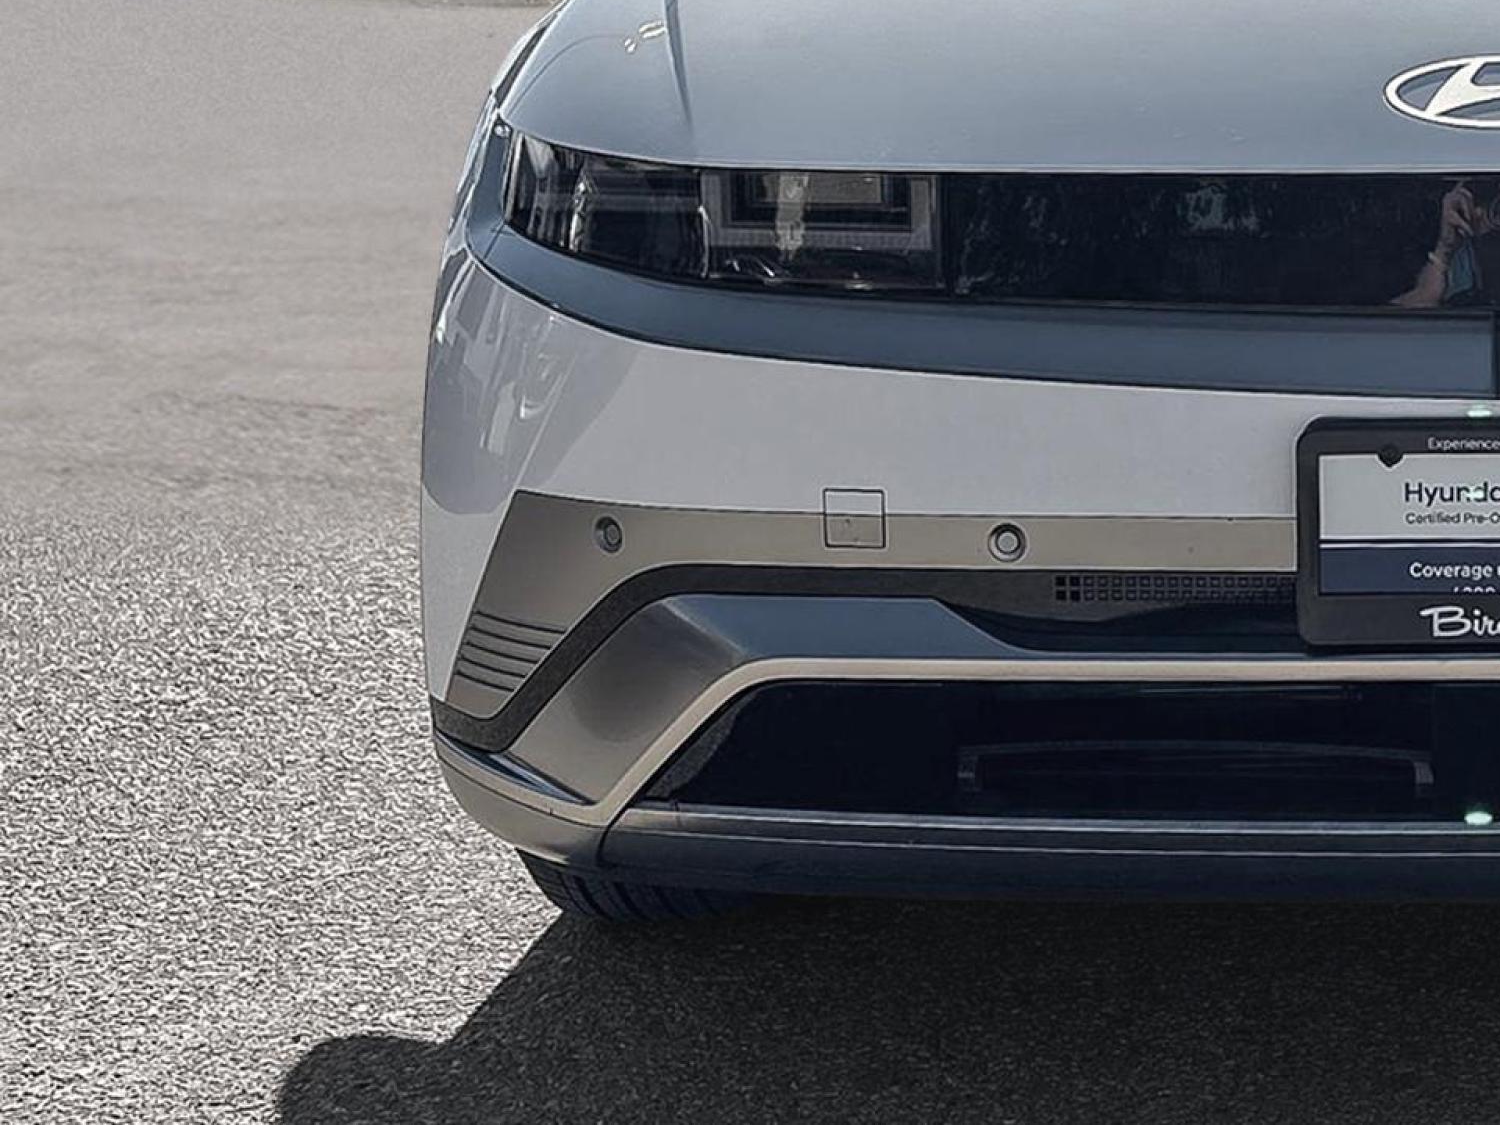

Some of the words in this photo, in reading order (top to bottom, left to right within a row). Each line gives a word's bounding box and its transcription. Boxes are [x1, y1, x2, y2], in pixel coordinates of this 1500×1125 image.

[1427, 437, 1500, 451] Experience
[1405, 511, 1461, 524] Certified
[1409, 562, 1493, 581] Coverage
